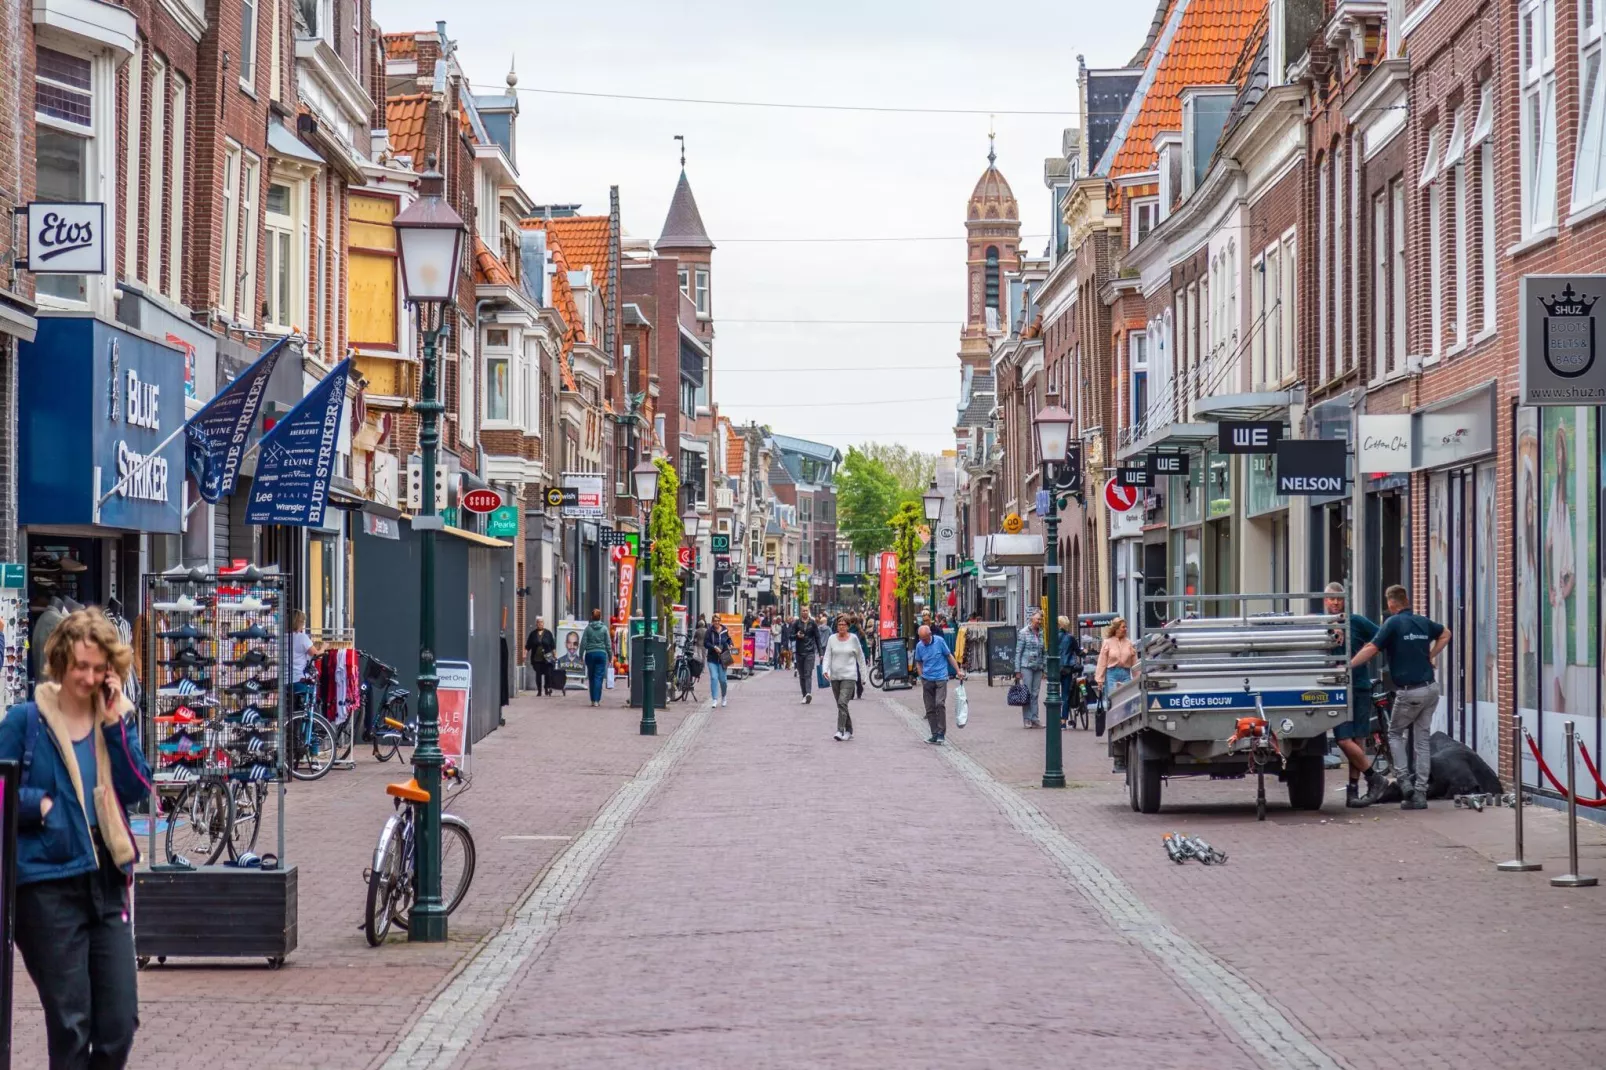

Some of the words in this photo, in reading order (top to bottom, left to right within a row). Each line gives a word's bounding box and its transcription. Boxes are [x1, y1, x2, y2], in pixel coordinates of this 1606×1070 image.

[38, 212, 92, 246] Etos
[1555, 305, 1582, 314] SHUZ
[1550, 322, 1588, 332] BOOTS
[1556, 354, 1584, 364] BAGS
[1531, 386, 1606, 398] www.shuz.n
[128, 368, 160, 430] BLUE
[222, 445, 240, 492] BLUE
[232, 375, 266, 444] STRIKER
[1233, 428, 1268, 446] WE
[316, 404, 338, 478] STRIKER
[1364, 436, 1390, 450] Cotton
[284, 458, 313, 466] ELVINE
[1157, 458, 1180, 471] WE
[118, 440, 168, 502] STRIKER
[1126, 472, 1146, 483] WE
[1282, 477, 1342, 491] NELSON
[256, 492, 273, 502] Lee
[308, 480, 326, 522] BLUE
[470, 496, 496, 506] SCORE
[276, 503, 306, 514] Wrangler
[493, 520, 516, 528] Pearle
[1207, 697, 1232, 705] BOUW
